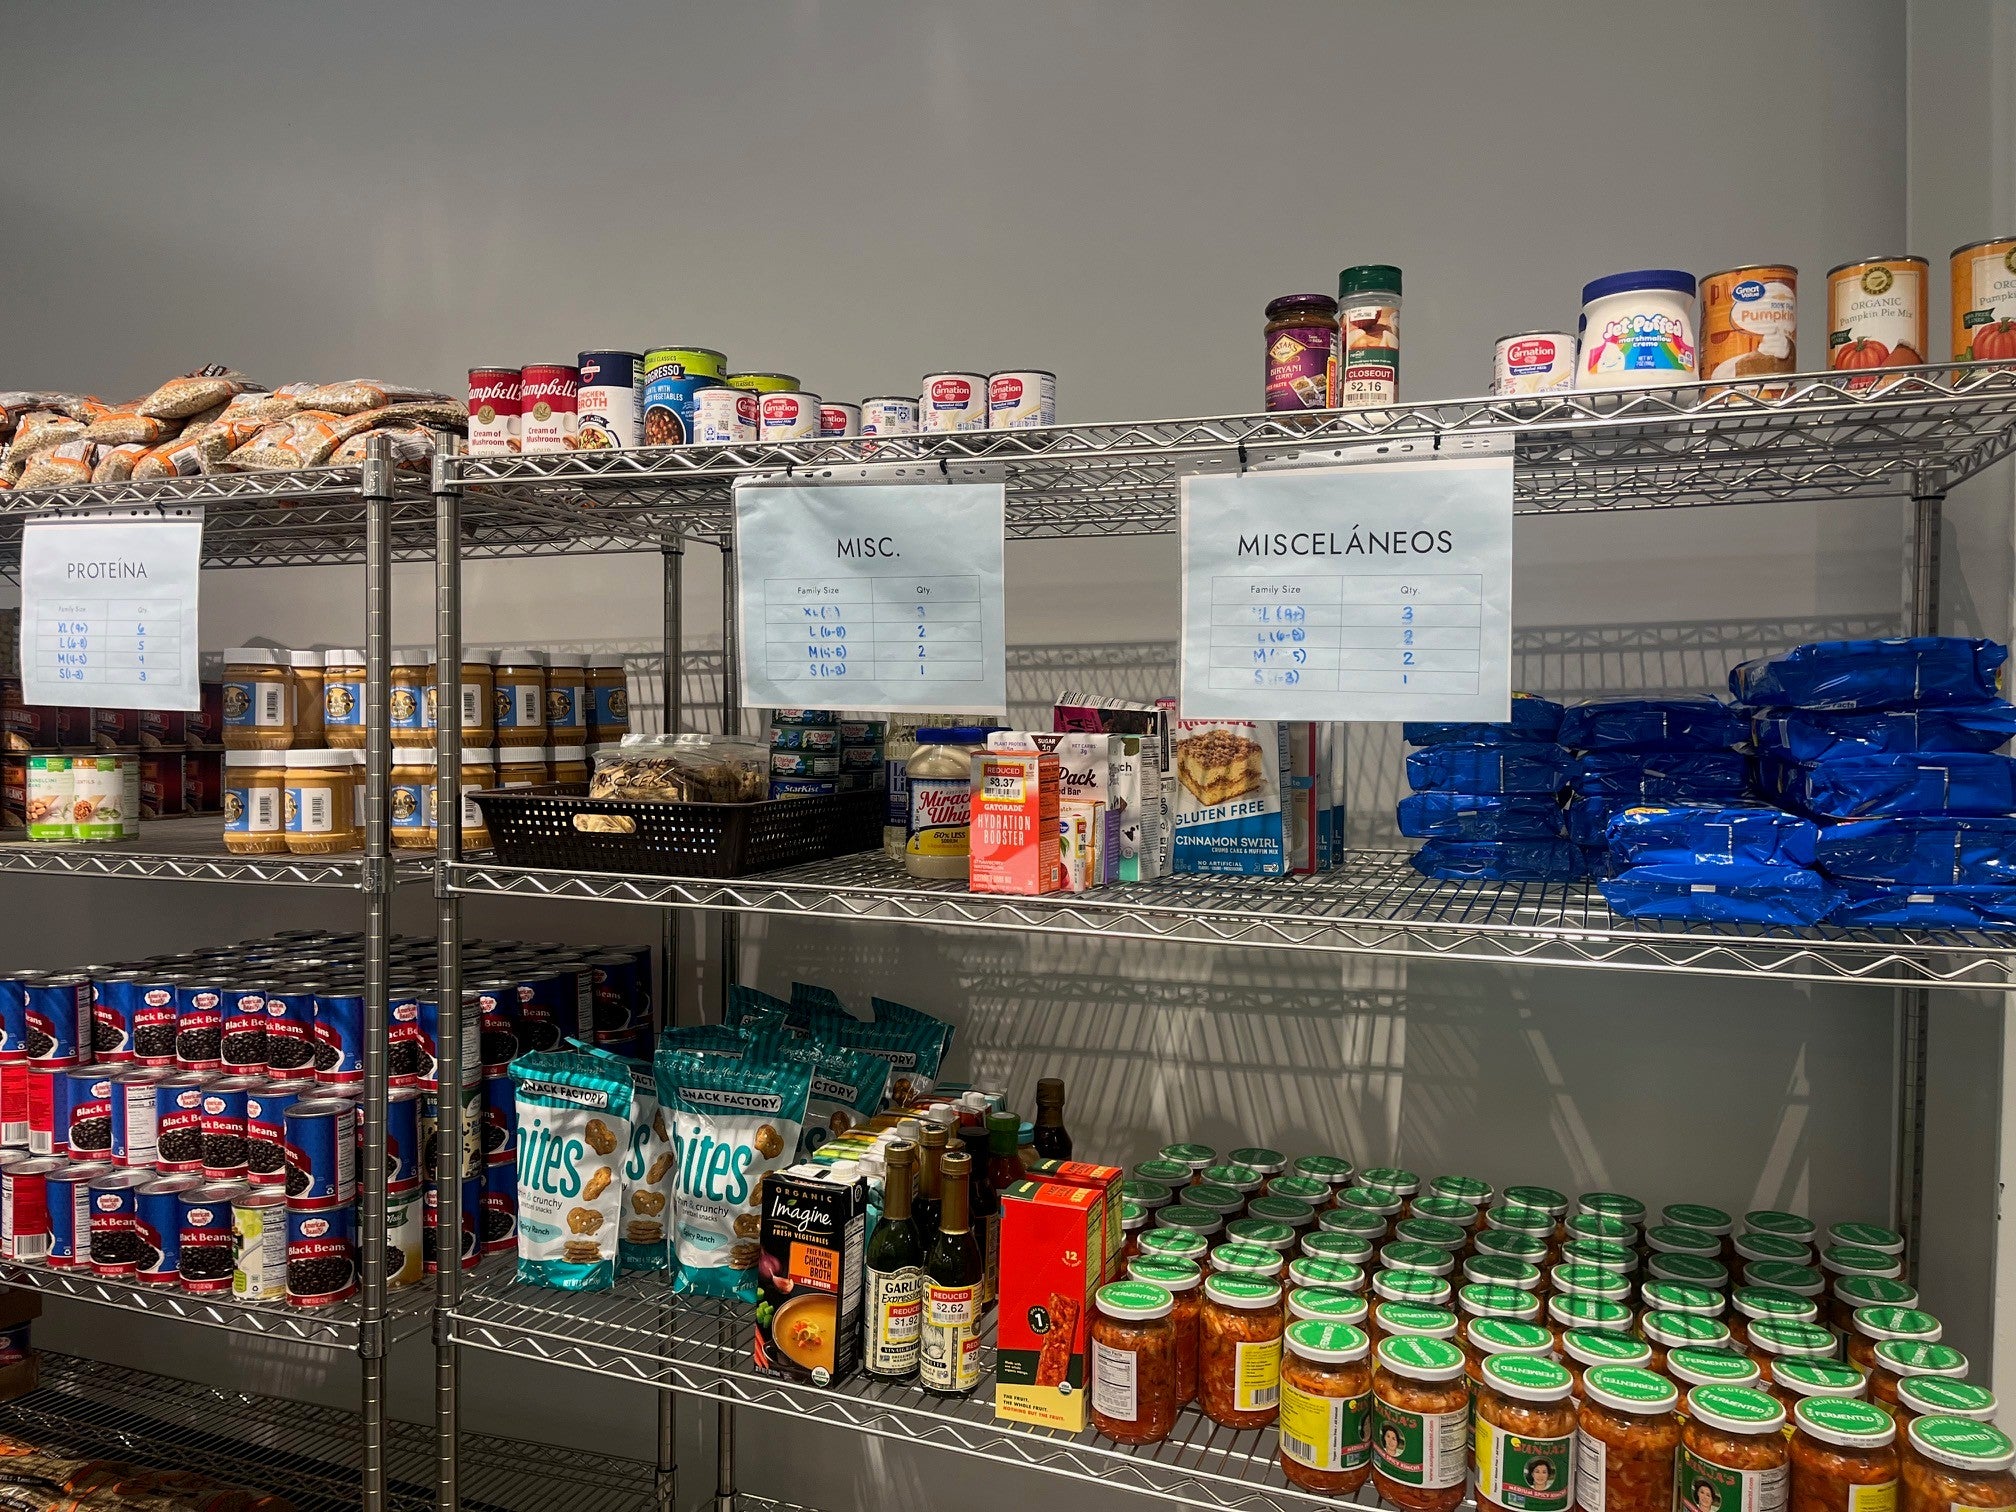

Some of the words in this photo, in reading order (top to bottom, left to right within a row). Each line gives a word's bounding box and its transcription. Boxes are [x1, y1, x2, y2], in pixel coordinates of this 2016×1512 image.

[1736, 285, 1760, 295] Great
[1741, 292, 1760, 300] Value
[1851, 298, 1901, 311] ORGANIC
[1741, 309, 1795, 322] Pumpkin
[1840, 311, 1878, 326] Pumpkin
[1881, 309, 1895, 317] Pie
[1898, 309, 1913, 319] Mix
[1604, 314, 1683, 339] Jet-Puffed
[1618, 336, 1672, 344] marshmallow
[1509, 346, 1554, 362] Carnation
[1270, 364, 1302, 376] BIRYANI
[1349, 370, 1391, 378] CLOSEOUT
[657, 385, 671, 394] WITH
[933, 384, 970, 397] Carnation
[991, 383, 1022, 396] Carnation
[1351, 382, 1382, 392] $2.16
[653, 394, 683, 402] VEGETABLES
[764, 399, 798, 414] Carnation
[472, 438, 505, 446] Mushroom
[1237, 524, 1453, 557] MISCELÁNEOS
[837, 537, 901, 559] MISC.
[67, 557, 148, 579] PROTEÍNA
[798, 587, 821, 595] Family
[916, 586, 933, 596] Qty.
[1251, 585, 1279, 595] Family
[1282, 585, 1301, 594] Size
[1401, 586, 1420, 596] Qty.
[803, 608, 818, 617] XL
[917, 606, 927, 619] 3
[1402, 606, 1414, 622] 3
[58, 622, 67, 633] XL
[137, 623, 145, 633] 6
[810, 626, 816, 637] L
[918, 625, 927, 638] 2
[60, 638, 65, 648] L
[1258, 633, 1265, 642] L
[138, 641, 144, 650] 5
[918, 645, 927, 658] 2
[139, 655, 144, 664] 4
[1403, 652, 1415, 665] 2
[920, 665, 925, 676] 1
[139, 672, 146, 681] 3
[1404, 675, 1407, 684] 1
[987, 767, 1020, 775] REDUCED
[990, 778, 1015, 788] $3.37
[784, 785, 819, 793] StarKist
[1067, 787, 1082, 796] Bar
[984, 804, 1024, 813] GATORADE
[1176, 807, 1226, 826] GLUTEN
[1231, 801, 1265, 816] FREE
[977, 815, 1031, 831] HYDRATION
[984, 831, 1025, 846] BOOSTER
[1175, 835, 1238, 847] CINNAMON
[1241, 837, 1279, 848] SWIRL
[135, 1013, 155, 1023] Black
[523, 1008, 551, 1017] Beans
[180, 1016, 204, 1027] Black
[225, 1021, 249, 1030] Black
[484, 1020, 511, 1028] Beans
[275, 1024, 304, 1034] Beans
[522, 1081, 558, 1095] SNACK
[560, 1087, 604, 1104] FACTORY
[682, 1089, 720, 1103] SNACK
[724, 1093, 778, 1109] FACTORY
[77, 1106, 102, 1117] Black
[162, 1116, 188, 1127] Black
[213, 1120, 244, 1132] Beans
[251, 1125, 278, 1137] Beans
[775, 1187, 833, 1204] ORGANIC
[532, 1195, 563, 1209] crunchy
[696, 1203, 730, 1217] crunchy
[532, 1226, 550, 1236] Ranch
[200, 1234, 232, 1242] Beans
[696, 1233, 716, 1244] Ranch
[772, 1228, 792, 1239] FRESH
[794, 1232, 829, 1246] VEGETABLES
[288, 1244, 312, 1256] Black
[314, 1244, 346, 1253] Beans
[806, 1247, 817, 1255] FREE
[818, 1250, 832, 1260] RANGE
[1065, 1251, 1078, 1261] 12
[804, 1255, 832, 1270] CHICKEN
[810, 1267, 832, 1281] BROTH
[800, 1277, 811, 1285] LOW
[812, 1279, 832, 1290] SODIUM
[1220, 1281, 1268, 1289] FERMENTED
[933, 1291, 968, 1300] REDUCED
[1112, 1290, 1158, 1302] FERMENTED
[937, 1303, 964, 1314] $2.62
[895, 1316, 918, 1327] $1.92
[1034, 1314, 1043, 1328] 1
[1685, 1357, 1741, 1368] FERMENTED
[1500, 1365, 1557, 1379] FERMENTED
[1603, 1376, 1663, 1392] FERMENTED
[1718, 1387, 1751, 1396] GLUTEN
[1708, 1394, 1765, 1414] FERMENTED
[1812, 1399, 1844, 1407] GLUTEN
[1845, 1402, 1867, 1411] FREE
[1003, 1406, 1026, 1415] NOTHING
[1815, 1411, 1875, 1423] FERMENTED
[1934, 1434, 1991, 1443] FERMENTED
[1508, 1485, 1533, 1495] MEDIUM
